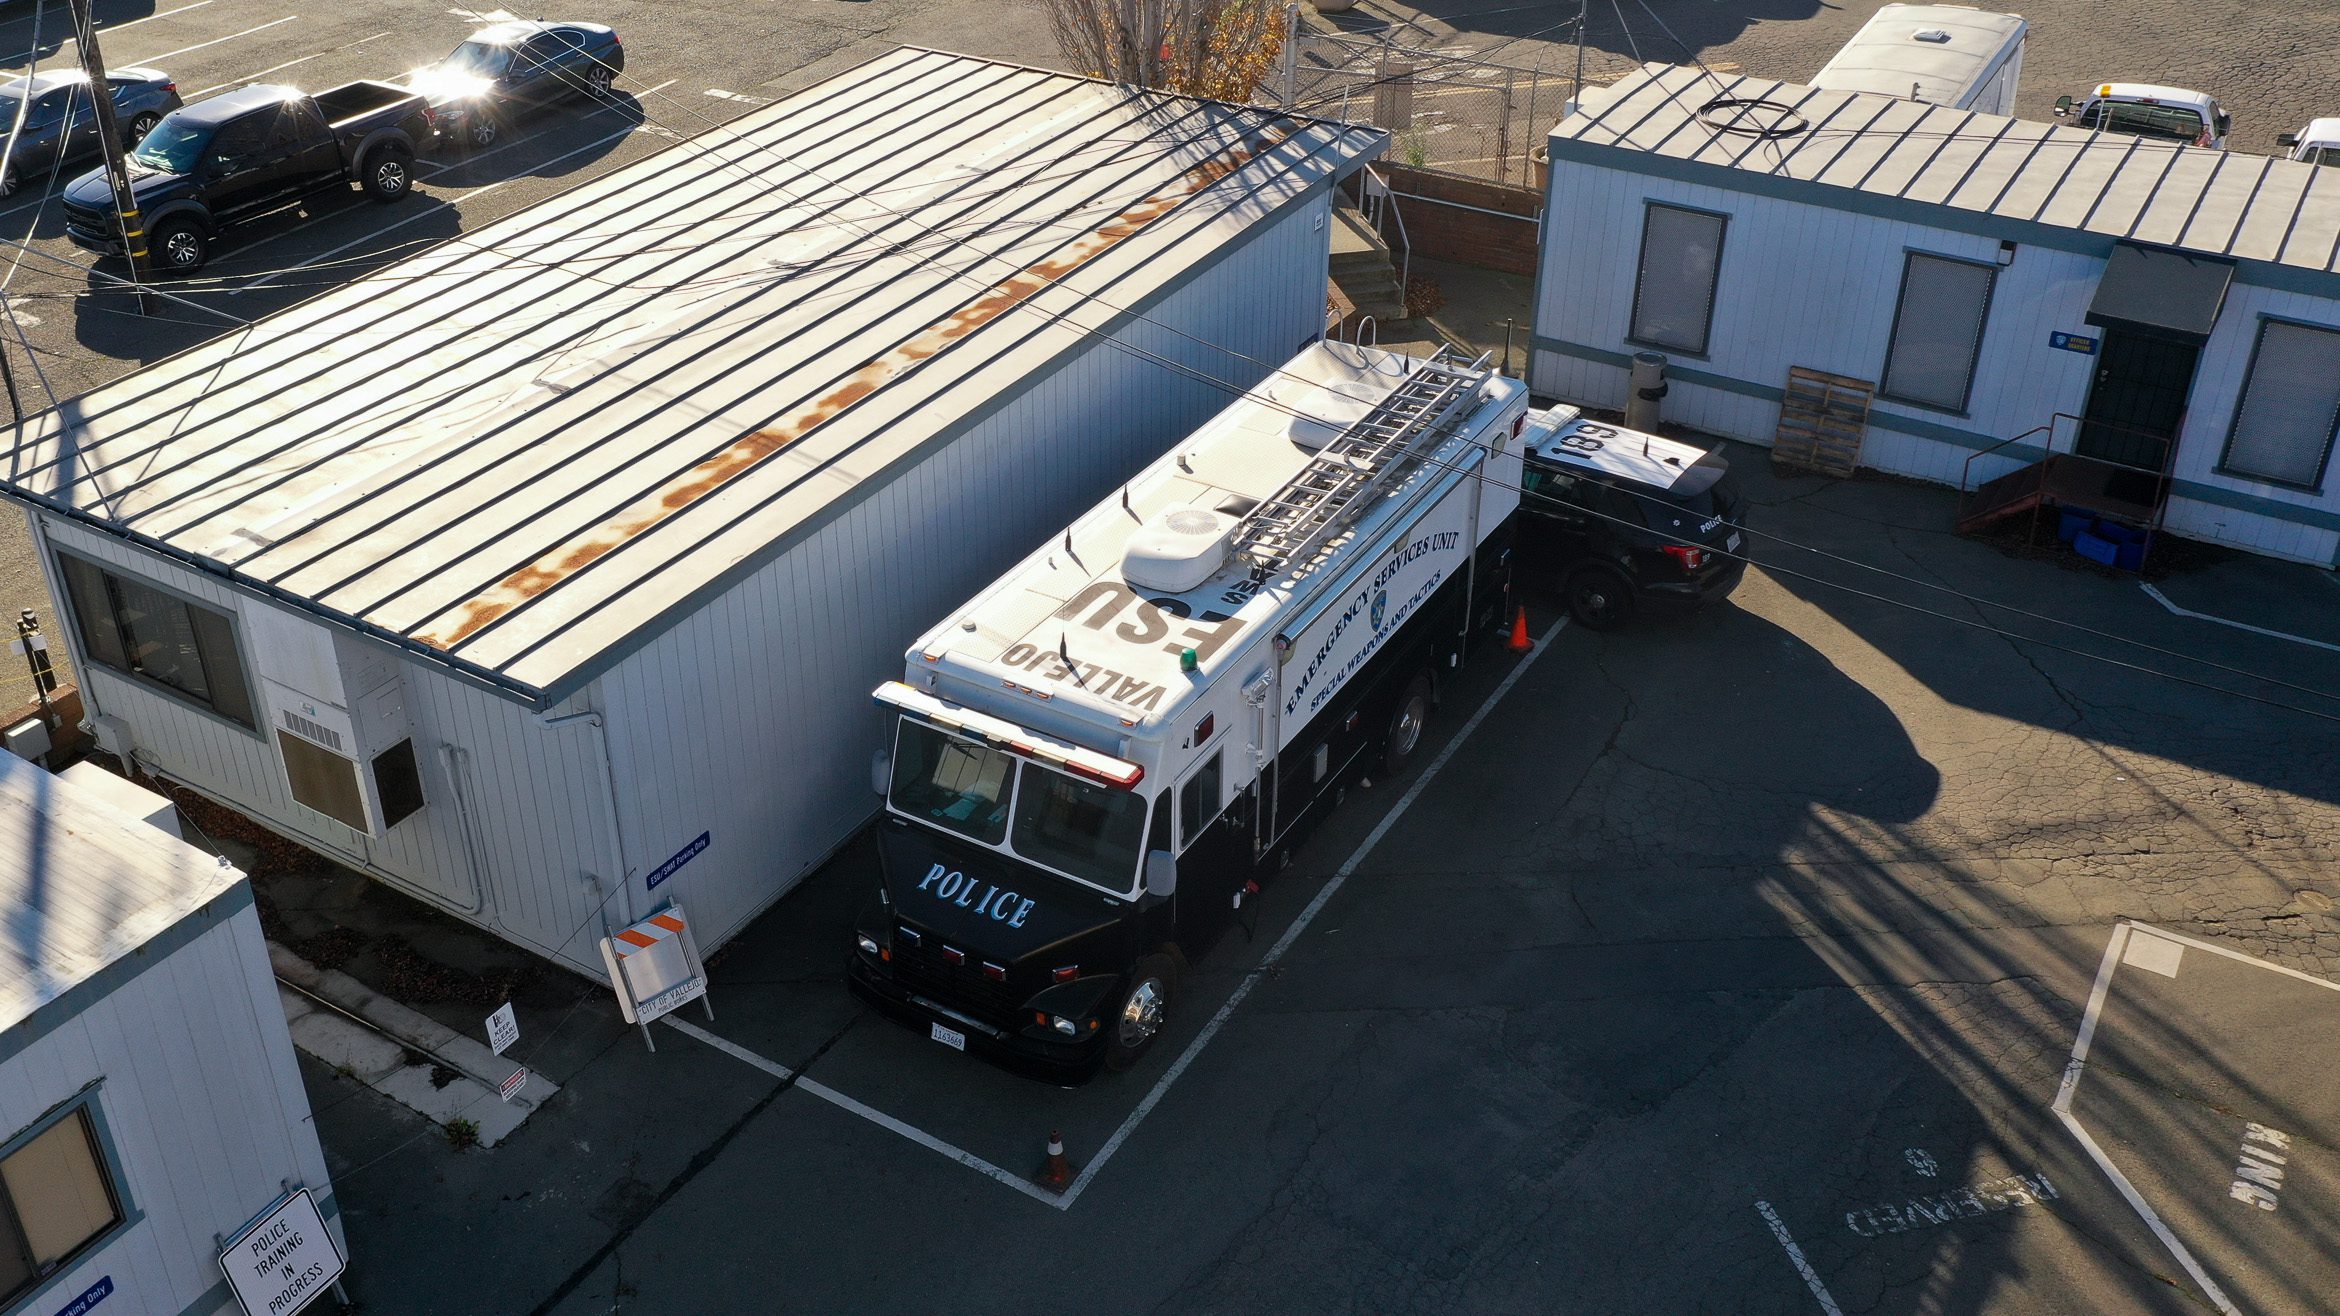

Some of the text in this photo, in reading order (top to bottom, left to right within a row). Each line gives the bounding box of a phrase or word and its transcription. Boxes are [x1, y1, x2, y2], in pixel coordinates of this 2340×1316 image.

[1551, 424, 1618, 460] 189
[1700, 514, 1723, 533] POLICE
[1053, 581, 1248, 663] ESU
[1284, 531, 1459, 716] EMERGENCY SERVICES UNIT
[1310, 569, 1441, 712] SPECIAL WEAPONS AND TACTICS
[1000, 643, 1167, 711] VALLEJO
[650, 860, 676, 885] ESU/SWAT
[916, 862, 1036, 929] POLICE
[641, 979, 701, 1015] CITY OF VALLEJO
[493, 1025, 516, 1046] CLEAR!
[494, 1021, 511, 1037] KEEP
[2229, 1121, 2291, 1211] KING
[1846, 1172, 2060, 1238] RESERVED
[251, 1218, 290, 1258] POLICE
[253, 1231, 304, 1278] TRAINING
[268, 1262, 324, 1315] PROGRESS
[280, 1262, 295, 1280] IN
[87, 1285, 106, 1303] Only
